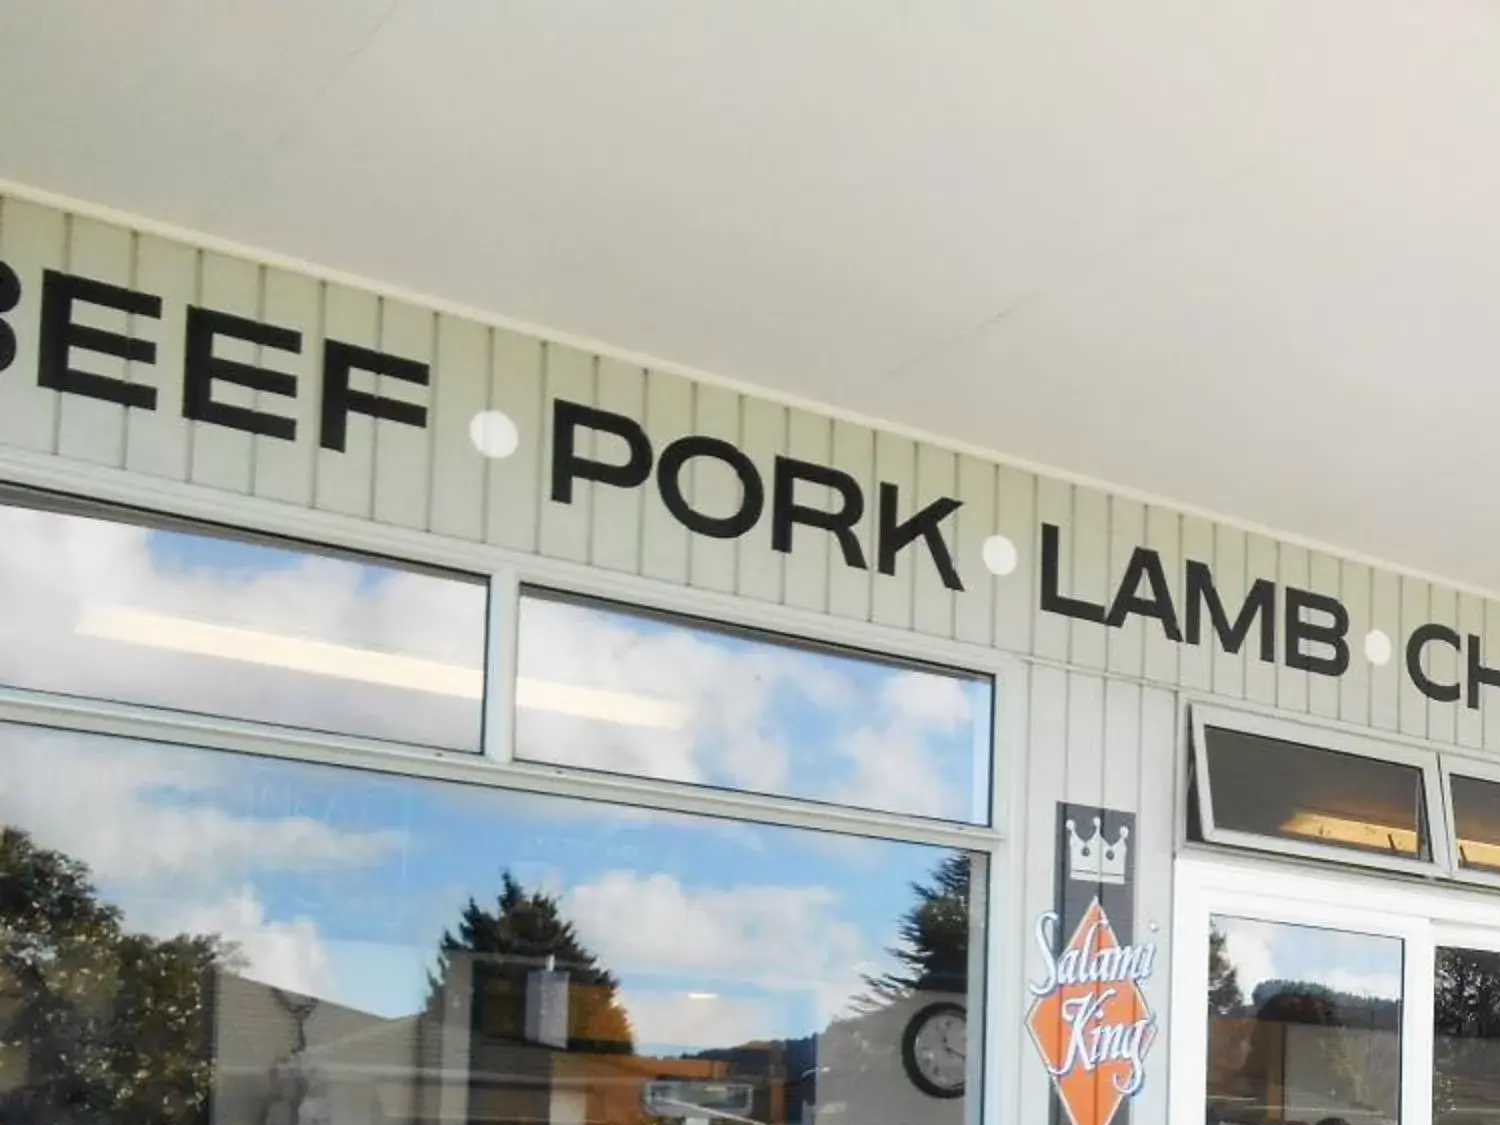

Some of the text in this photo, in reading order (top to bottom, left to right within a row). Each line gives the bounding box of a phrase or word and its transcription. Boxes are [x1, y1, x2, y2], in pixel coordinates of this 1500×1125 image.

[0, 259, 431, 454] EEF
[550, 397, 966, 592] PORK
[1040, 522, 1351, 678] LAMB
[1029, 910, 1159, 999] Salami
[1048, 988, 1157, 1100] King
